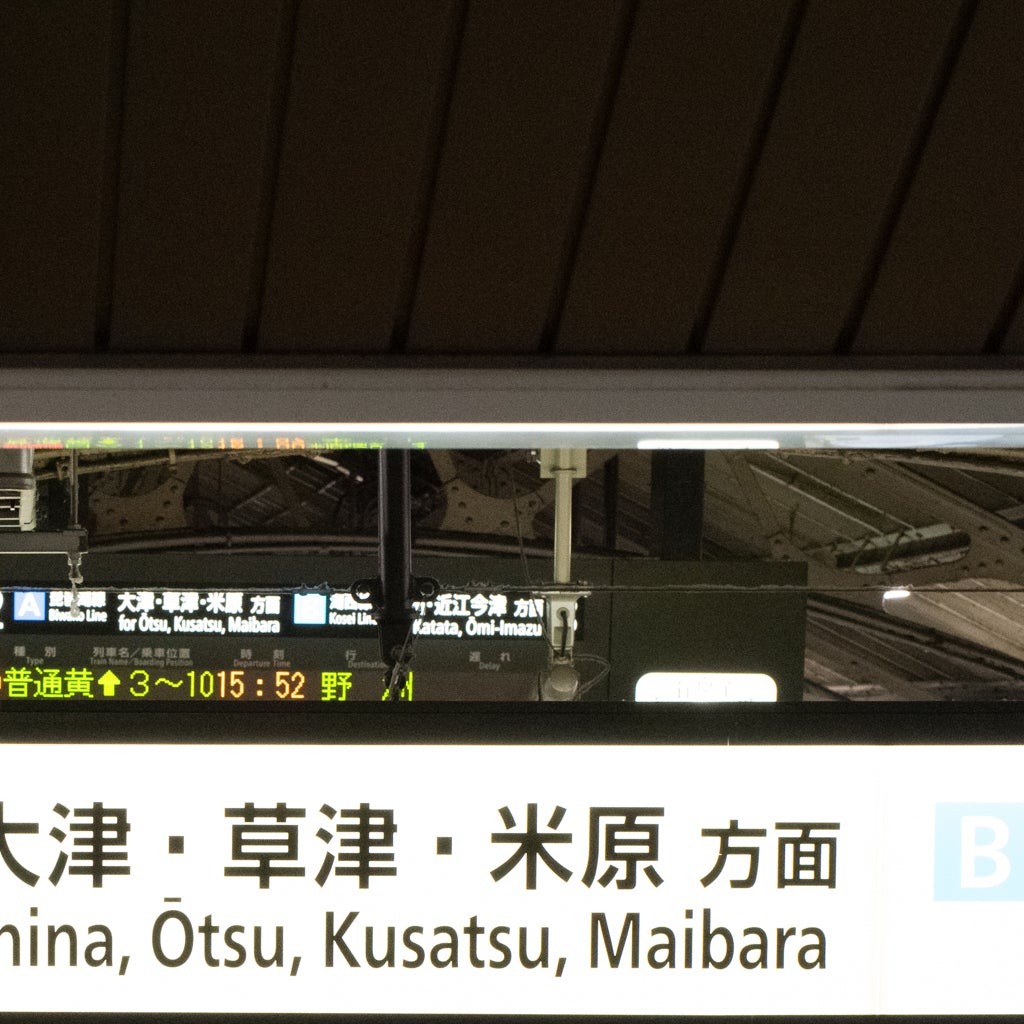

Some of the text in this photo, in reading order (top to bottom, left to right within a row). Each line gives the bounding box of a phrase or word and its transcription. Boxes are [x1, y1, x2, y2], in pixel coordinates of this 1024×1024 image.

[18, 592, 42, 617] A
[48, 607, 108, 622] Biwao Line
[250, 594, 281, 615] 方面
[413, 593, 507, 617] ・近江今津
[118, 612, 280, 636] for Ōtsu, Kusatsu, Maibara
[329, 612, 356, 625] Kosei
[413, 619, 462, 638] Katata,
[26, 657, 44, 667] Type
[348, 660, 388, 669] Destinatio
[3, 667, 94, 699] 普通黄
[700, 819, 841, 889] 方面
[960, 815, 1011, 889] B
[152, 897, 302, 976] Ōtsu,
[326, 911, 567, 978] Kusatsu,
[591, 908, 828, 970] Maibara
